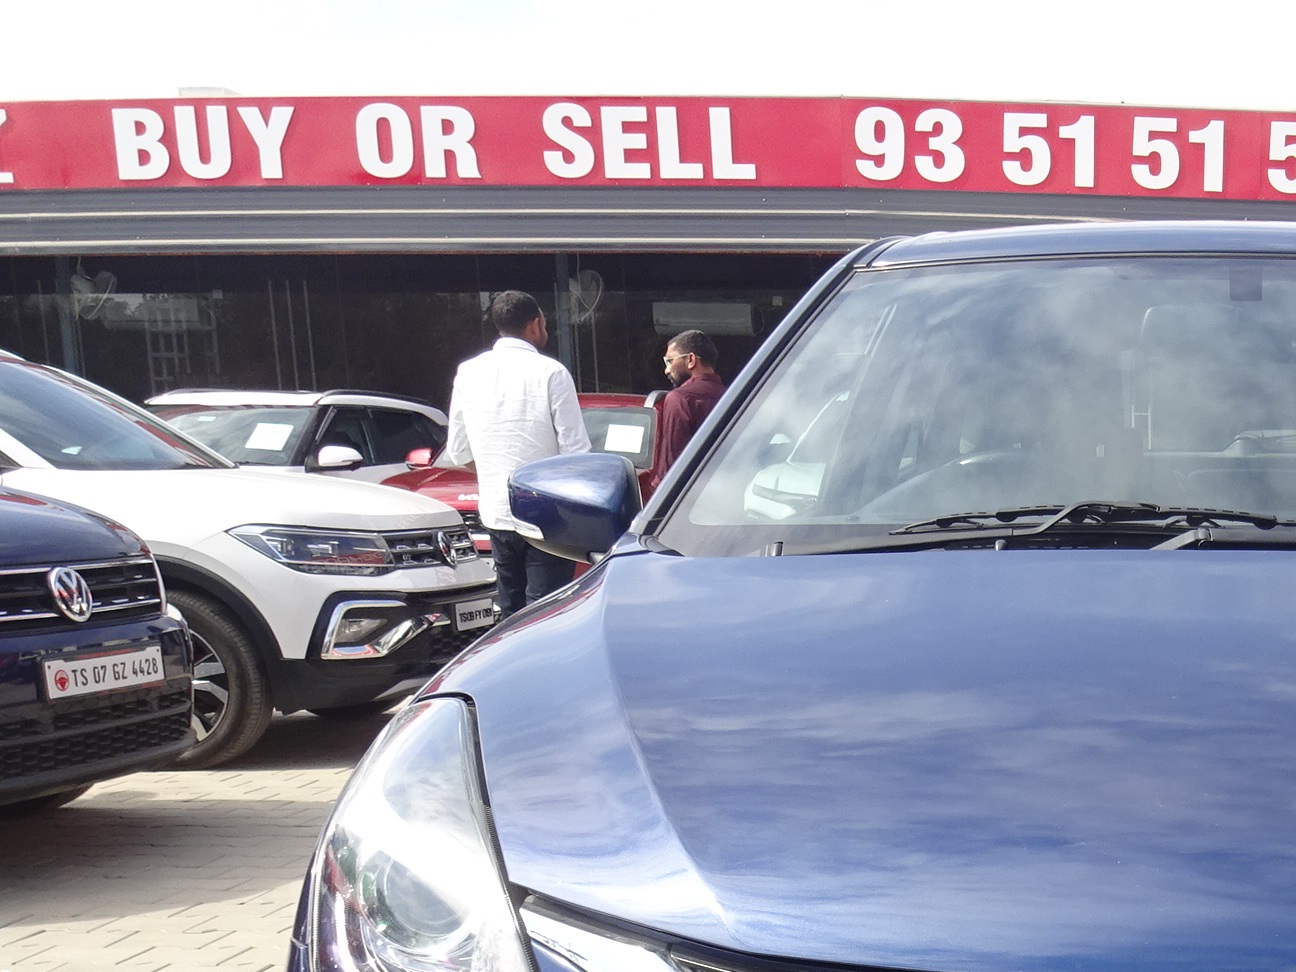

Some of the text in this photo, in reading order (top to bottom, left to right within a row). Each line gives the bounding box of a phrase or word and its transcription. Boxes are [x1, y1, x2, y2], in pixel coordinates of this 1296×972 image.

[111, 105, 295, 180] BUY
[355, 102, 482, 178] OR
[541, 102, 757, 180] SELL
[854, 106, 965, 183] 93
[1002, 112, 1095, 188] 51
[1131, 116, 1225, 193] 51
[71, 657, 159, 687] TS 07 GZ 4428
